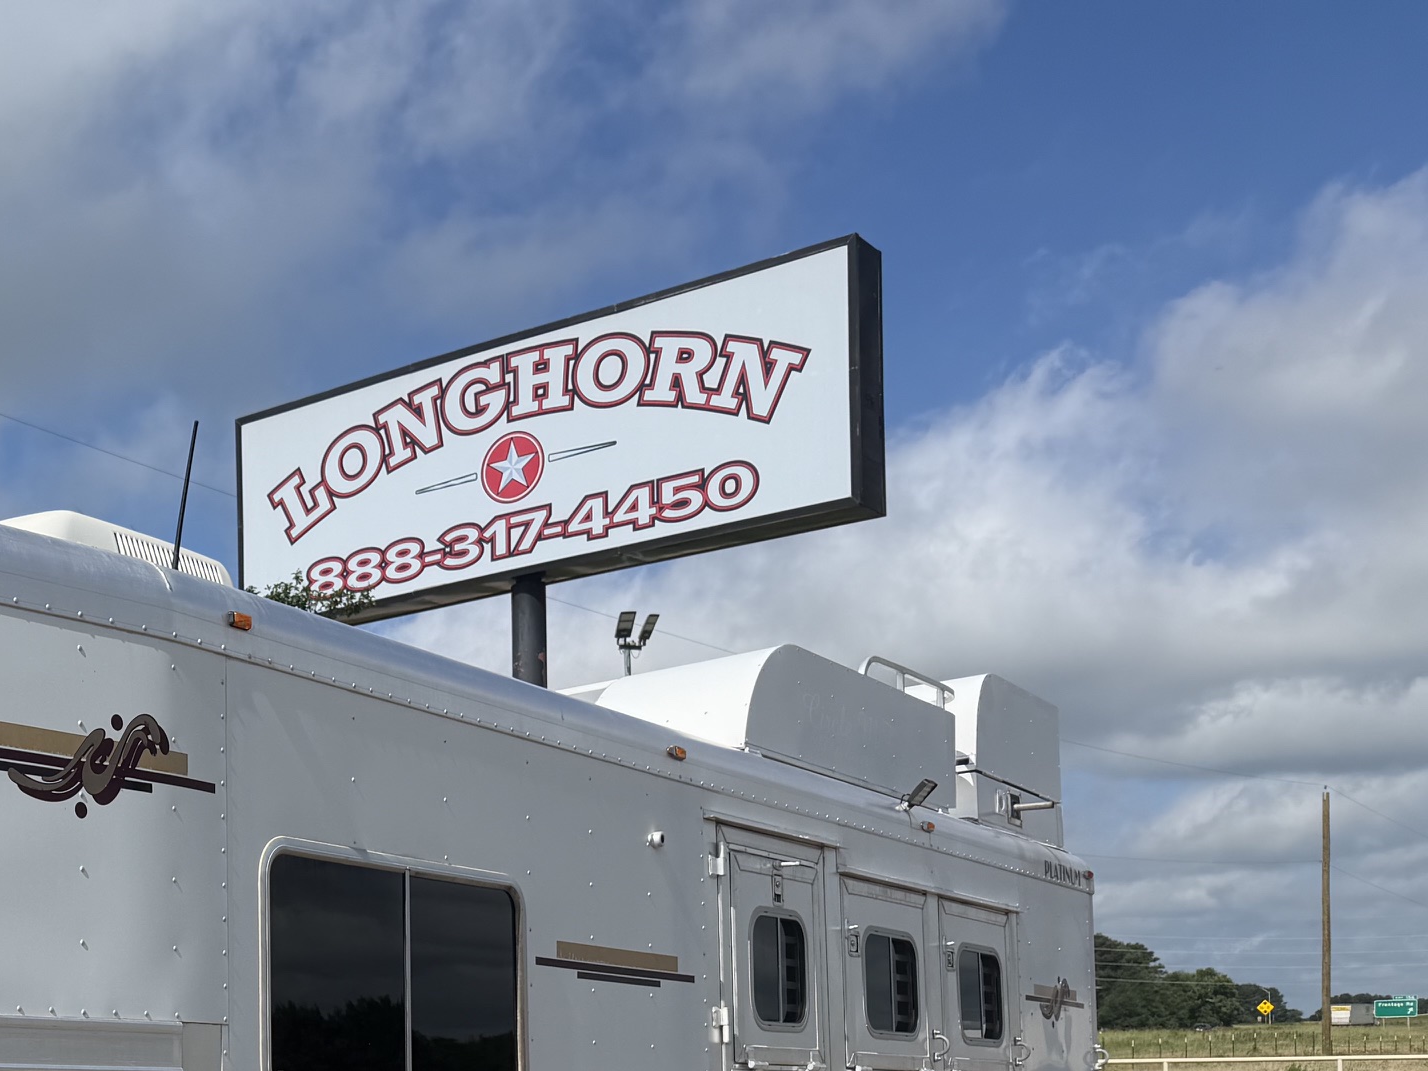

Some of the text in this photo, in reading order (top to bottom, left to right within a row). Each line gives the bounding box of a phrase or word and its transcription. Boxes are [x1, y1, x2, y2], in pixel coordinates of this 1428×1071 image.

[268, 330, 811, 544] LONGHORN
[306, 459, 759, 599] 888-317-4450
[1044, 860, 1081, 887] PLATINUM
